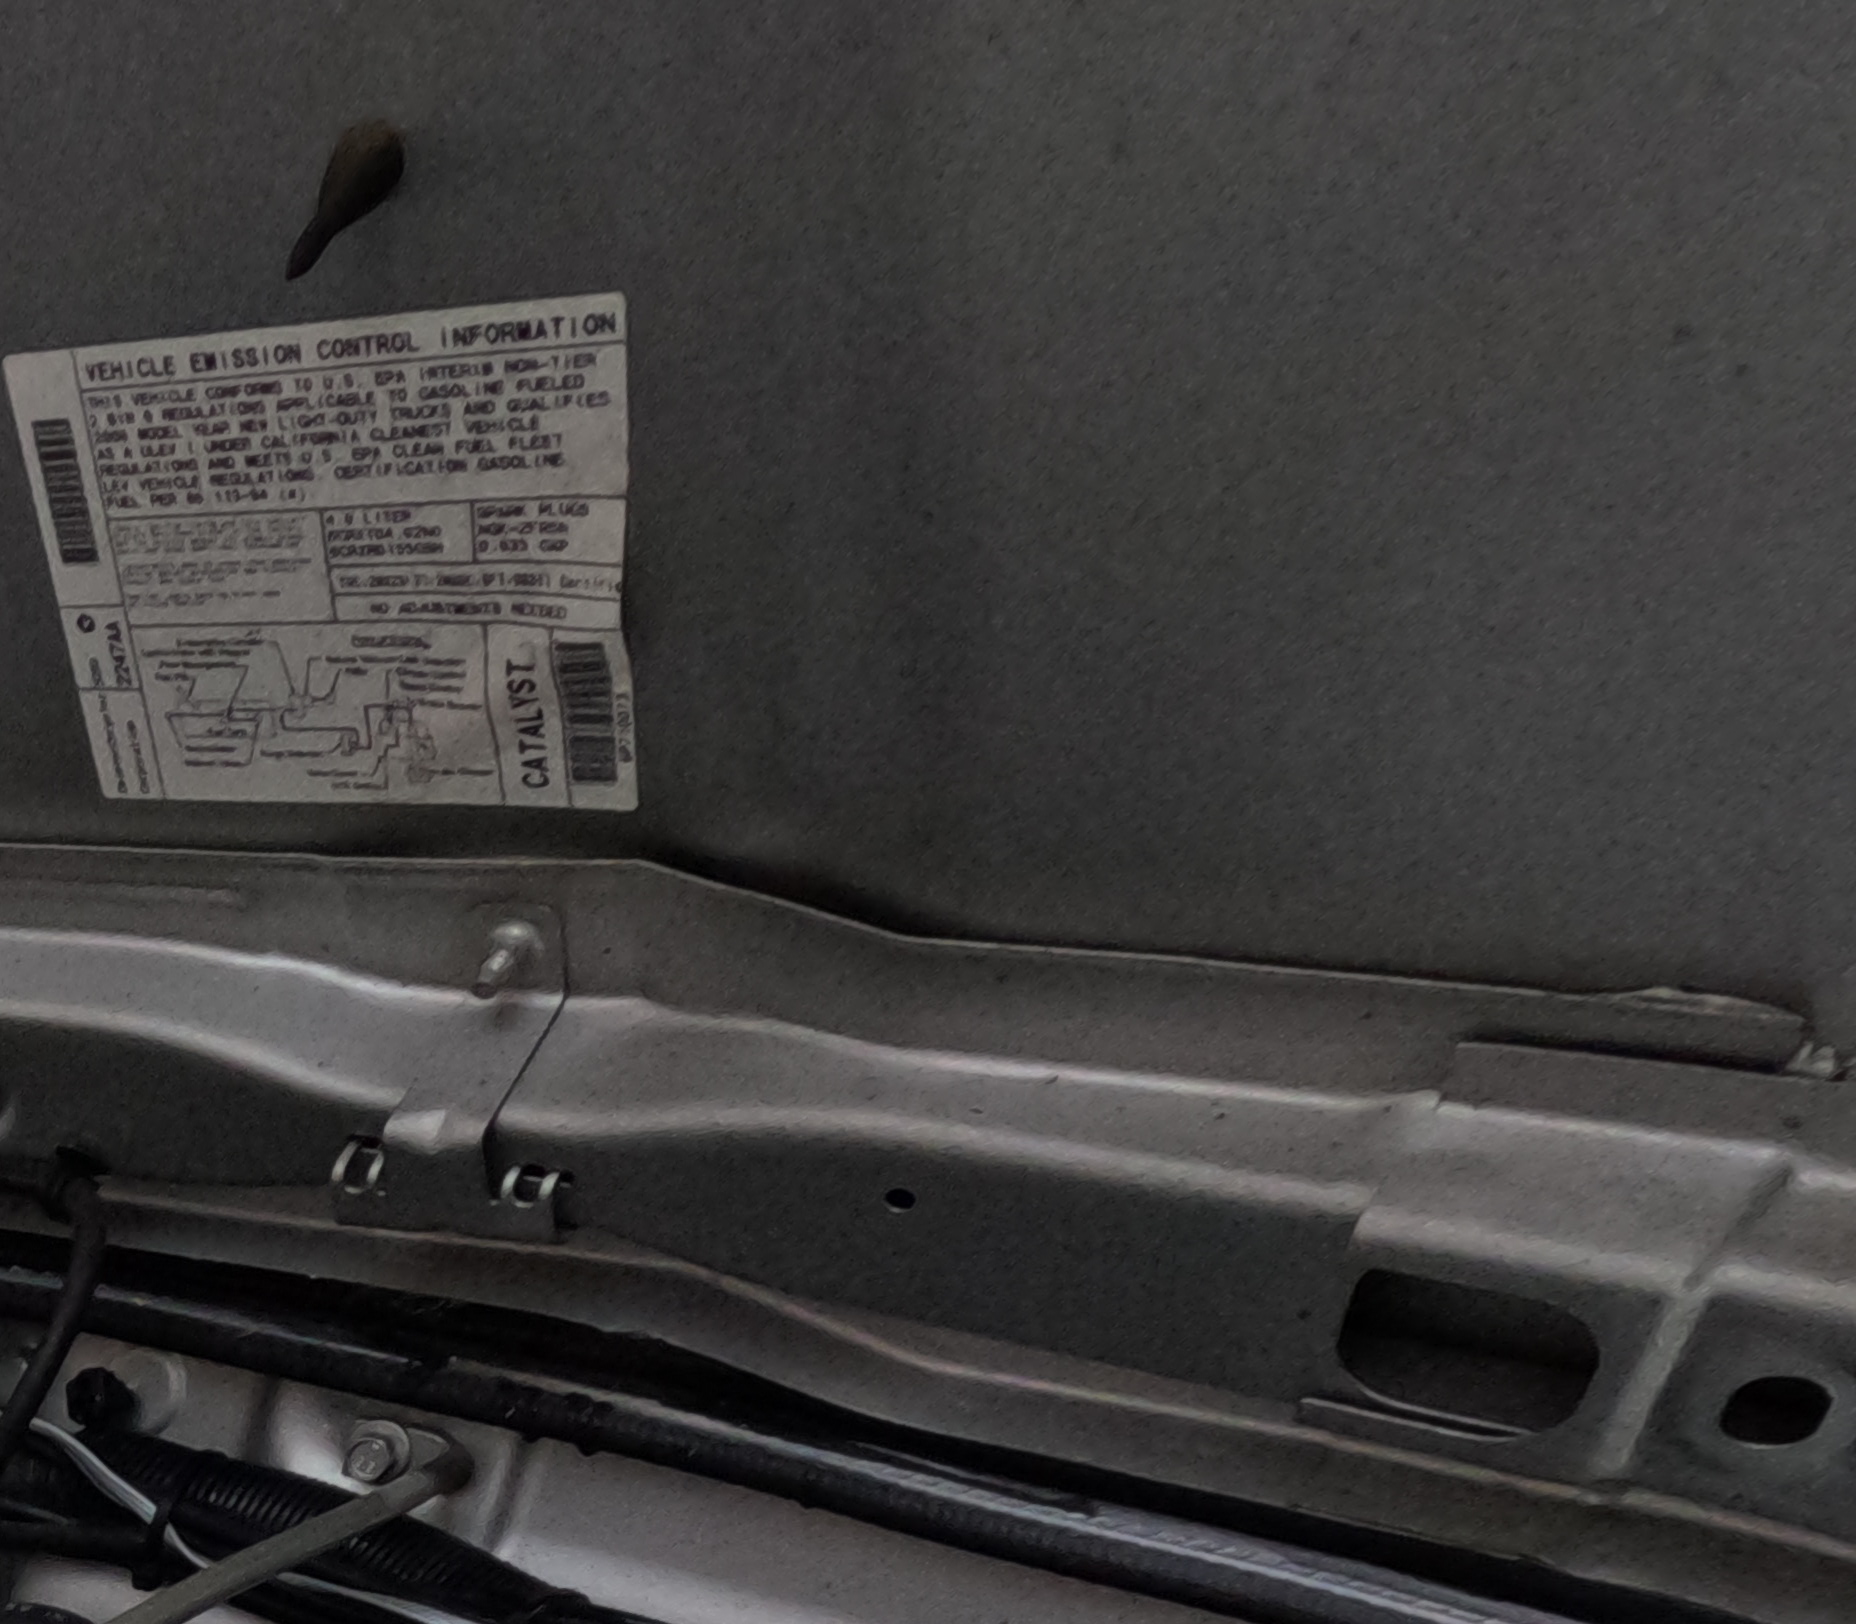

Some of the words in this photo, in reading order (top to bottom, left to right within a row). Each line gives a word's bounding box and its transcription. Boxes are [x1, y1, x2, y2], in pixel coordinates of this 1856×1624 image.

[85, 354, 177, 382] VEHICLE
[189, 343, 302, 373] EMISSION
[316, 330, 421, 361] CONTROL
[440, 311, 617, 349] INFORMATION
[130, 387, 197, 406] VEHICLE
[293, 376, 313, 392] TO
[389, 387, 408, 402] TO
[418, 378, 505, 401] GASOLINE
[515, 373, 586, 392] FUELED
[464, 415, 540, 435] VEHICLE
[139, 475, 200, 491] VEHICLE
[506, 658, 550, 790] CATALYST
